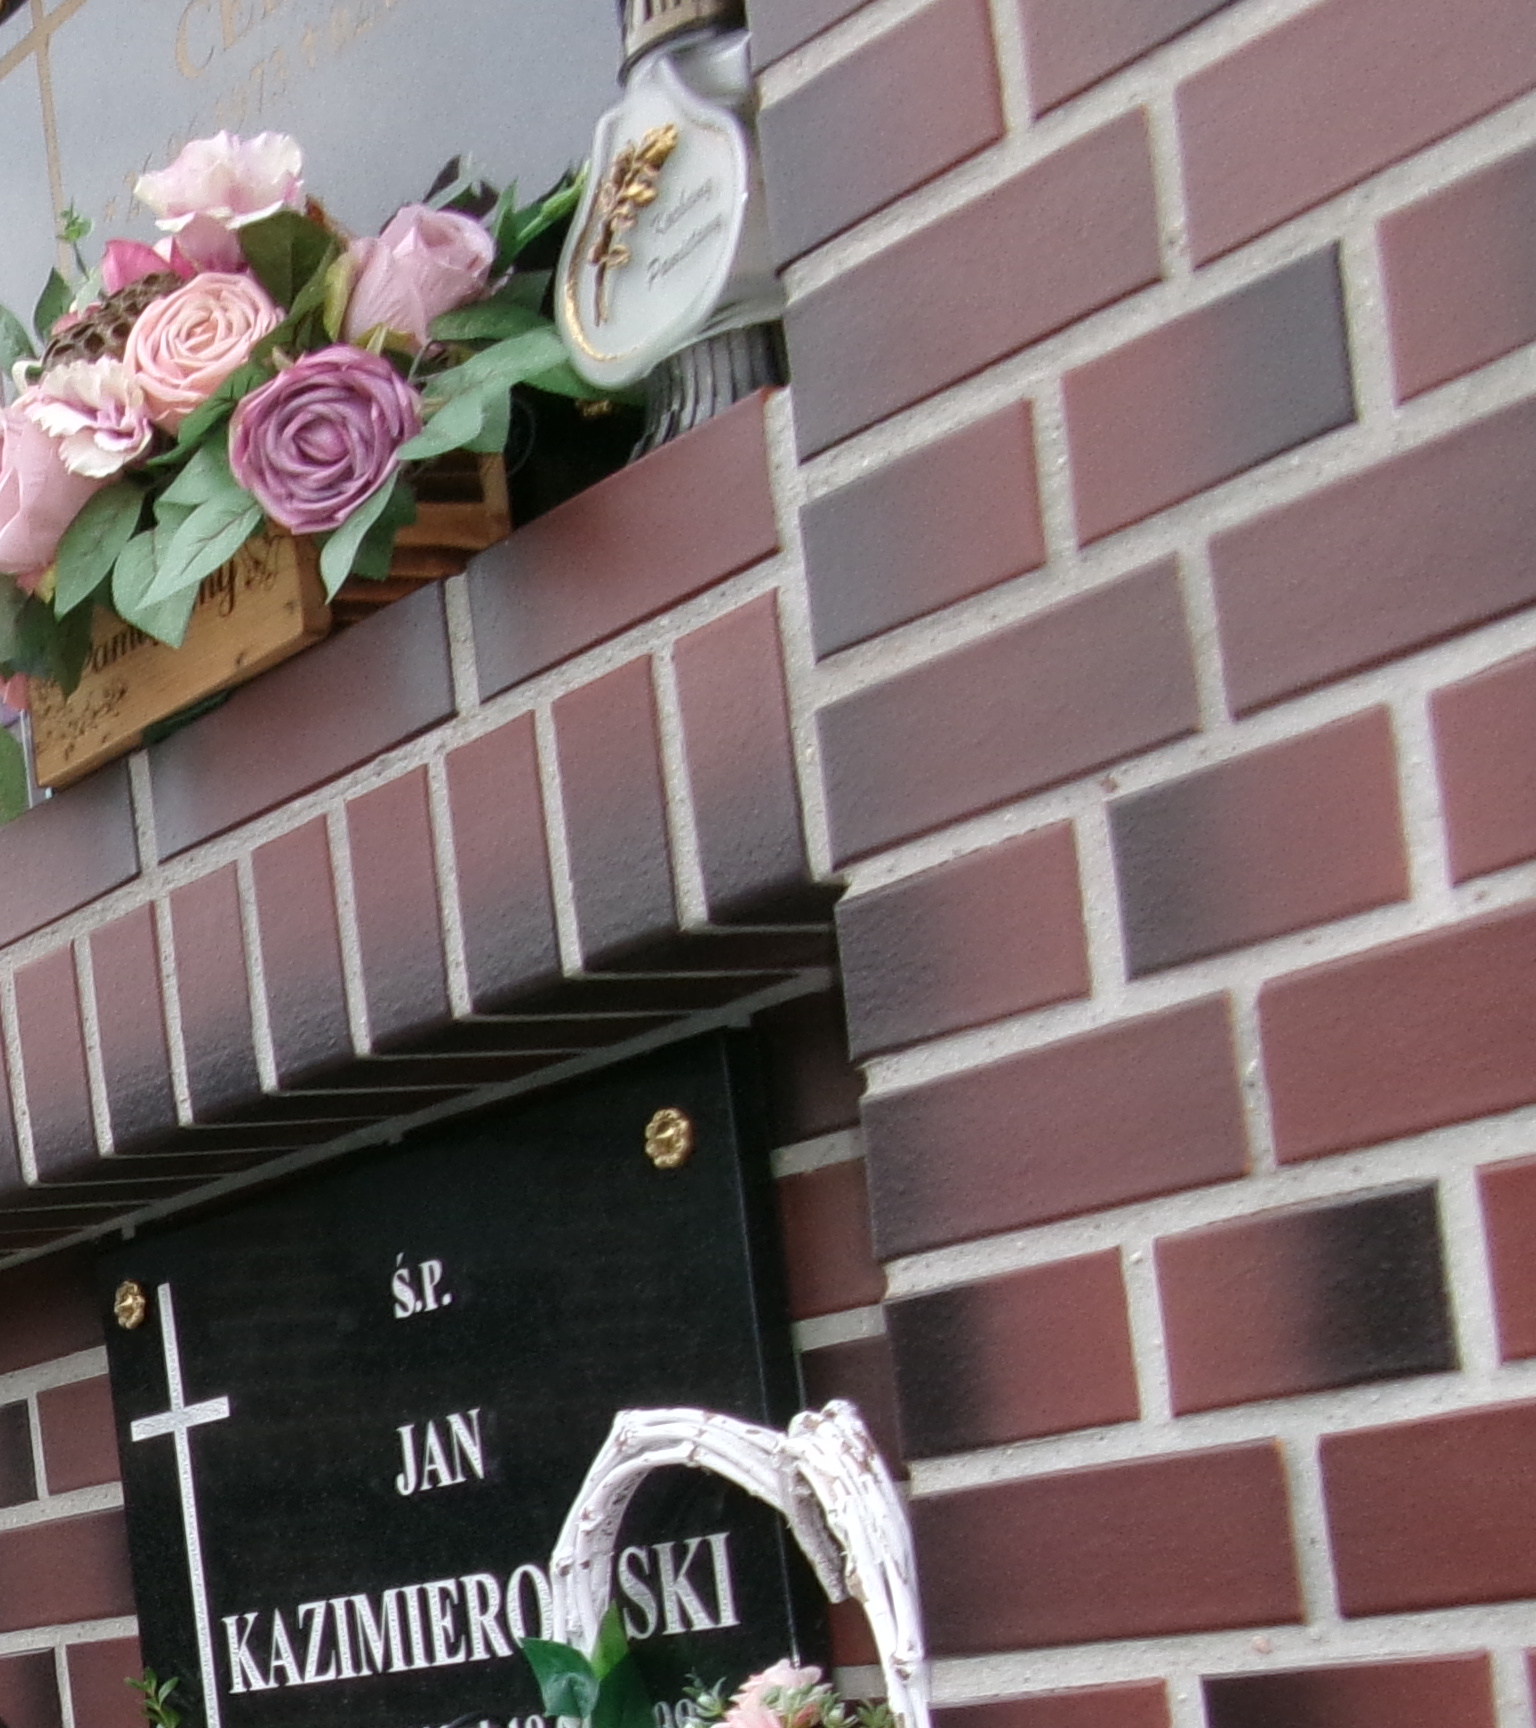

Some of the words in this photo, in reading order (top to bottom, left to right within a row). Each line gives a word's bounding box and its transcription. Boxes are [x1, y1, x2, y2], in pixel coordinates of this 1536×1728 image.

[391, 1251, 453, 1319] Ś.P.
[395, 1406, 485, 1497] JAN
[221, 1531, 741, 1695] KAZIMIEROSKI
